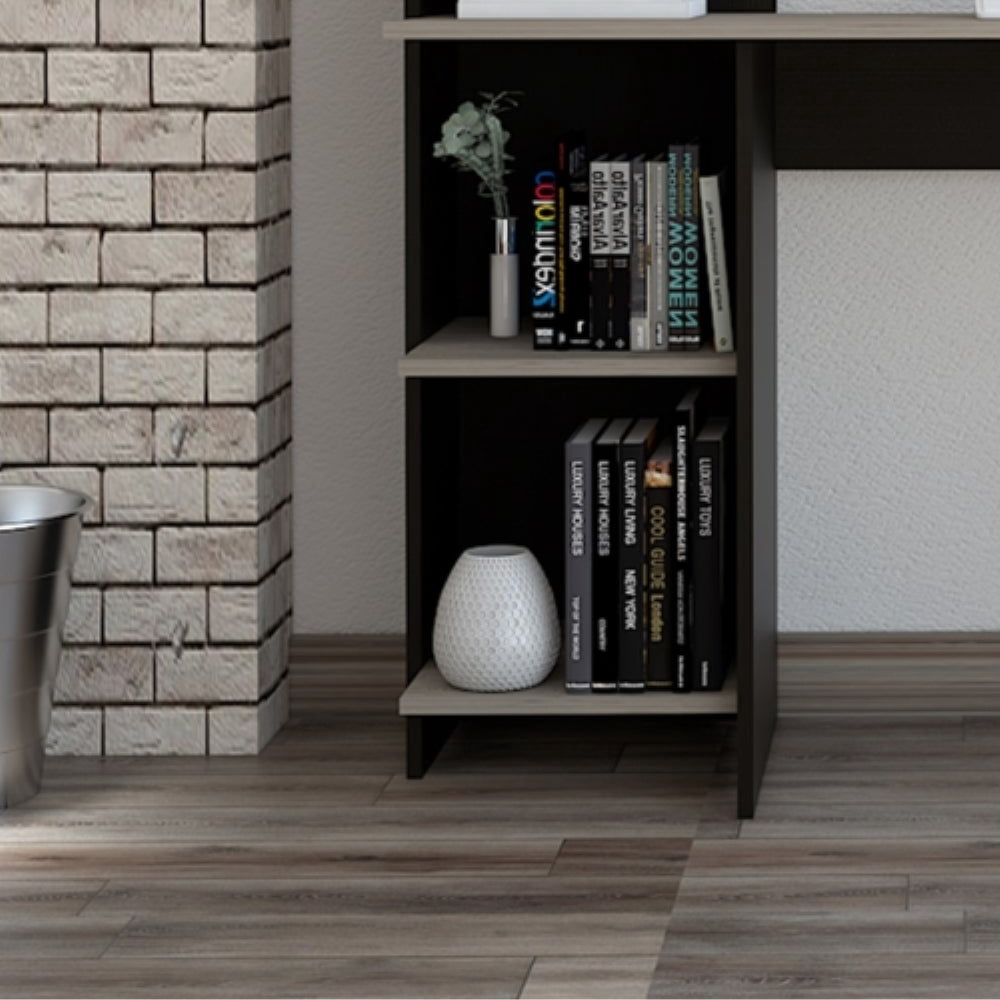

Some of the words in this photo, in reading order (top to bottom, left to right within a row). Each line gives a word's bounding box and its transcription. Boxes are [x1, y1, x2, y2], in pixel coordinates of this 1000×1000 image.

[572, 460, 584, 506] LUXURY
[598, 460, 611, 506] LUXURY
[624, 460, 638, 504] LUXURY
[699, 457, 713, 503] LUXURY
[571, 508, 584, 557] HOUSES
[598, 508, 611, 557] HOUSES
[624, 506, 638, 546] LIVING
[650, 504, 666, 545] COOL
[699, 505, 713, 538] TOYS
[624, 568, 637, 597] NEW
[650, 548, 667, 590] GUIDE
[624, 597, 637, 631] YORK
[650, 594, 664, 643] London
